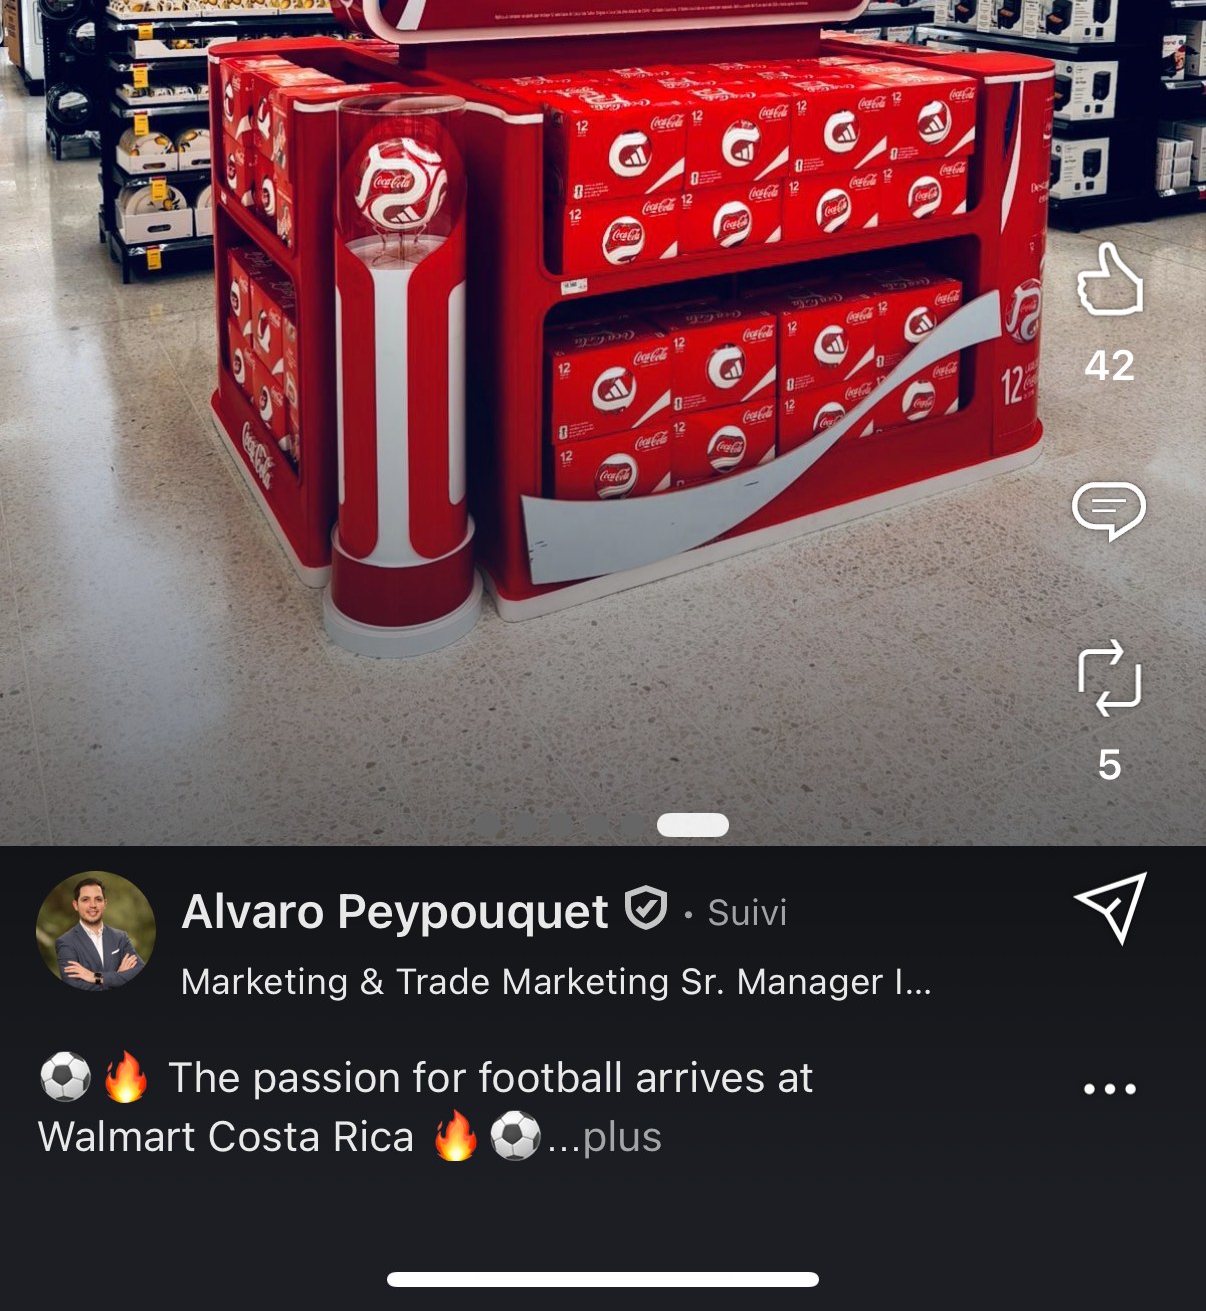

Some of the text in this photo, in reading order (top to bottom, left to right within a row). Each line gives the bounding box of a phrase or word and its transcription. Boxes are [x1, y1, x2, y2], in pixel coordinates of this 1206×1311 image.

[891, 91, 902, 101] 12
[949, 86, 976, 101] Coca-Cola
[796, 100, 807, 110] 12
[858, 95, 887, 110] Coca-Cola
[692, 110, 703, 121] 12
[758, 104, 790, 120] Coca-Cola
[576, 120, 588, 132] 12
[650, 113, 685, 130] Coca-Cola
[883, 169, 893, 178] 12
[939, 161, 967, 176] Coca-Cola
[373, 170, 412, 188] Coca-Cola
[789, 181, 799, 191] 12
[849, 173, 878, 189] Coca-Cola
[681, 193, 693, 204] 12
[749, 184, 779, 201] Coca-Cola
[915, 187, 938, 202] Coca-Cola
[642, 197, 676, 216] Coca-Cola
[824, 198, 848, 217] Coca-Cola
[569, 209, 582, 220] 12
[723, 214, 748, 231] Coca-Cola
[612, 228, 641, 241] Coca-Cola
[934, 289, 961, 305] Coca-Cola
[878, 301, 888, 311] 12
[846, 307, 874, 324] Coca-Cola
[743, 324, 775, 342] Coca-Cola
[787, 321, 797, 331] 12
[673, 337, 686, 348] 12
[633, 346, 669, 366] Coca-Cola
[558, 363, 571, 374] 12
[932, 361, 958, 379] Coca-Cola
[1001, 365, 1023, 406] 12
[784, 399, 795, 408] 12
[742, 405, 774, 424] Coca-Cola
[673, 422, 686, 433] 12
[635, 431, 669, 450] Coca-Cola
[716, 441, 744, 453] Coca-Cola
[560, 451, 573, 462] 12
[600, 468, 631, 482] Coca-Cola
